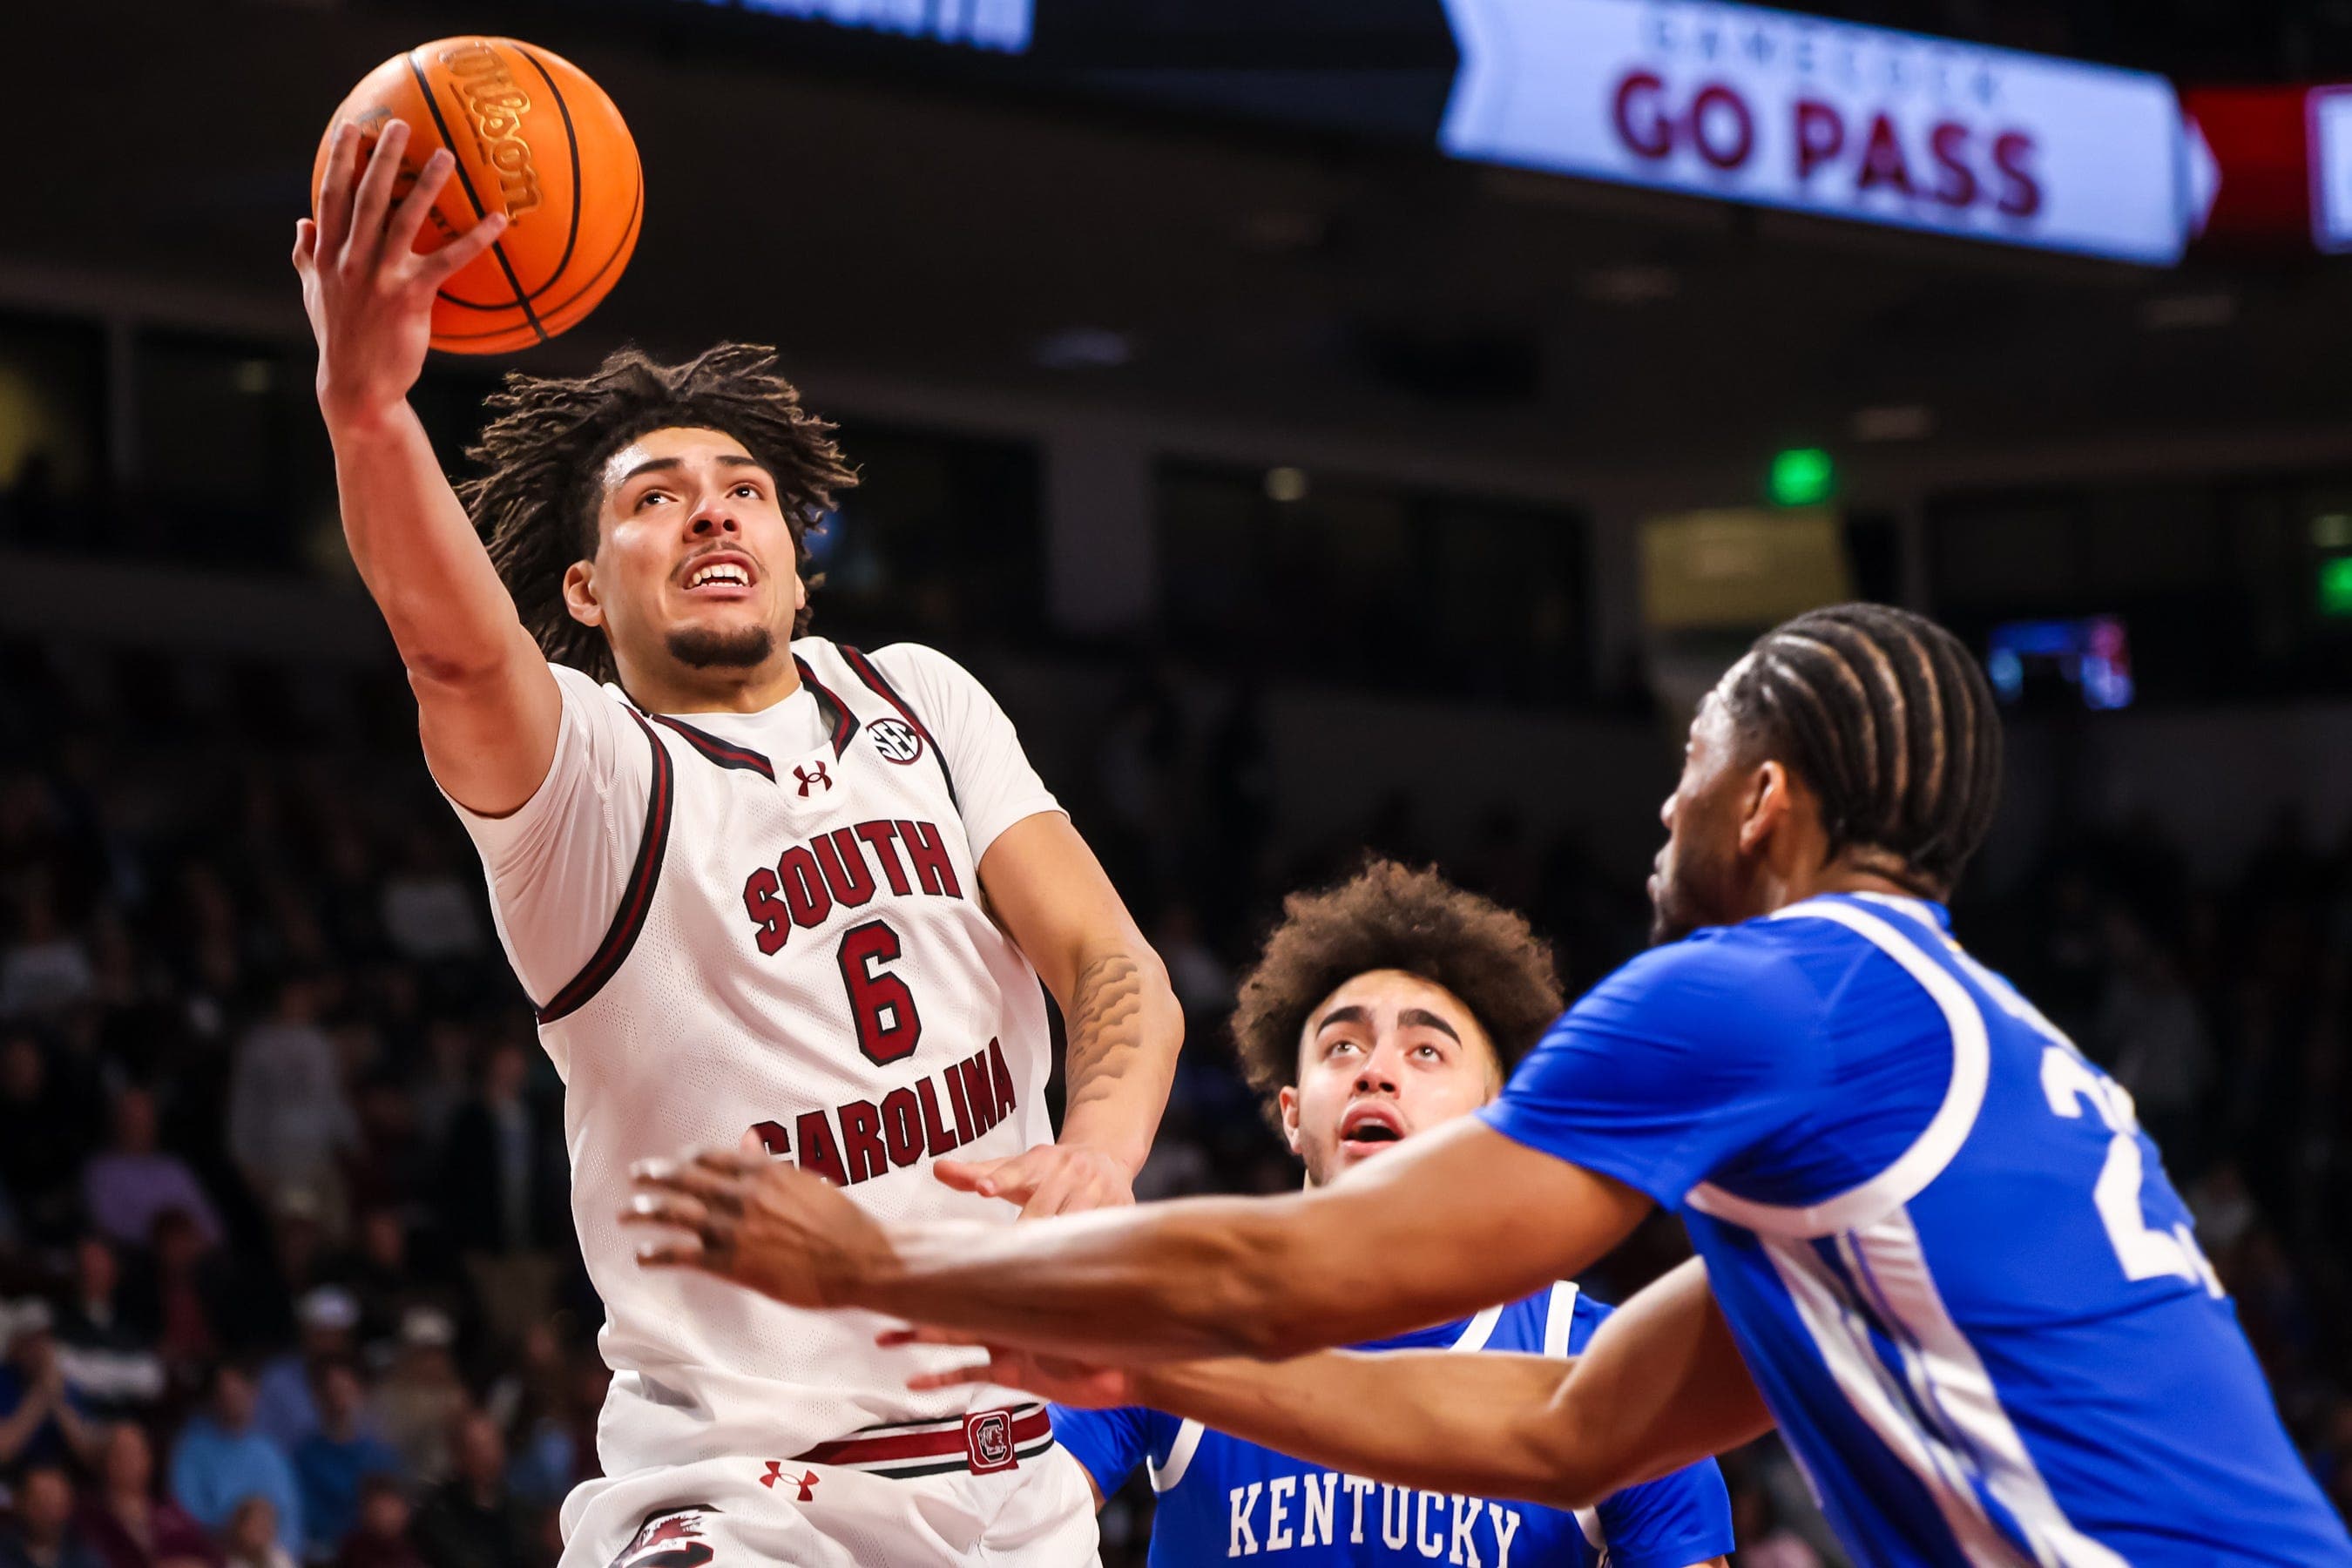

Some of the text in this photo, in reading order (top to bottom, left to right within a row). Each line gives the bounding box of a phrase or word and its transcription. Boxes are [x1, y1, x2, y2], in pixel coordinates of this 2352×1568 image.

[438, 41, 542, 222] Wilson
[1613, 68, 2043, 219] GO PASS
[868, 720, 920, 762] SEC
[743, 819, 963, 956] SOUTH
[836, 918, 922, 1067] 6
[2040, 1045, 2227, 1299] 2
[1227, 1471, 1521, 1568] KENTUCKY
